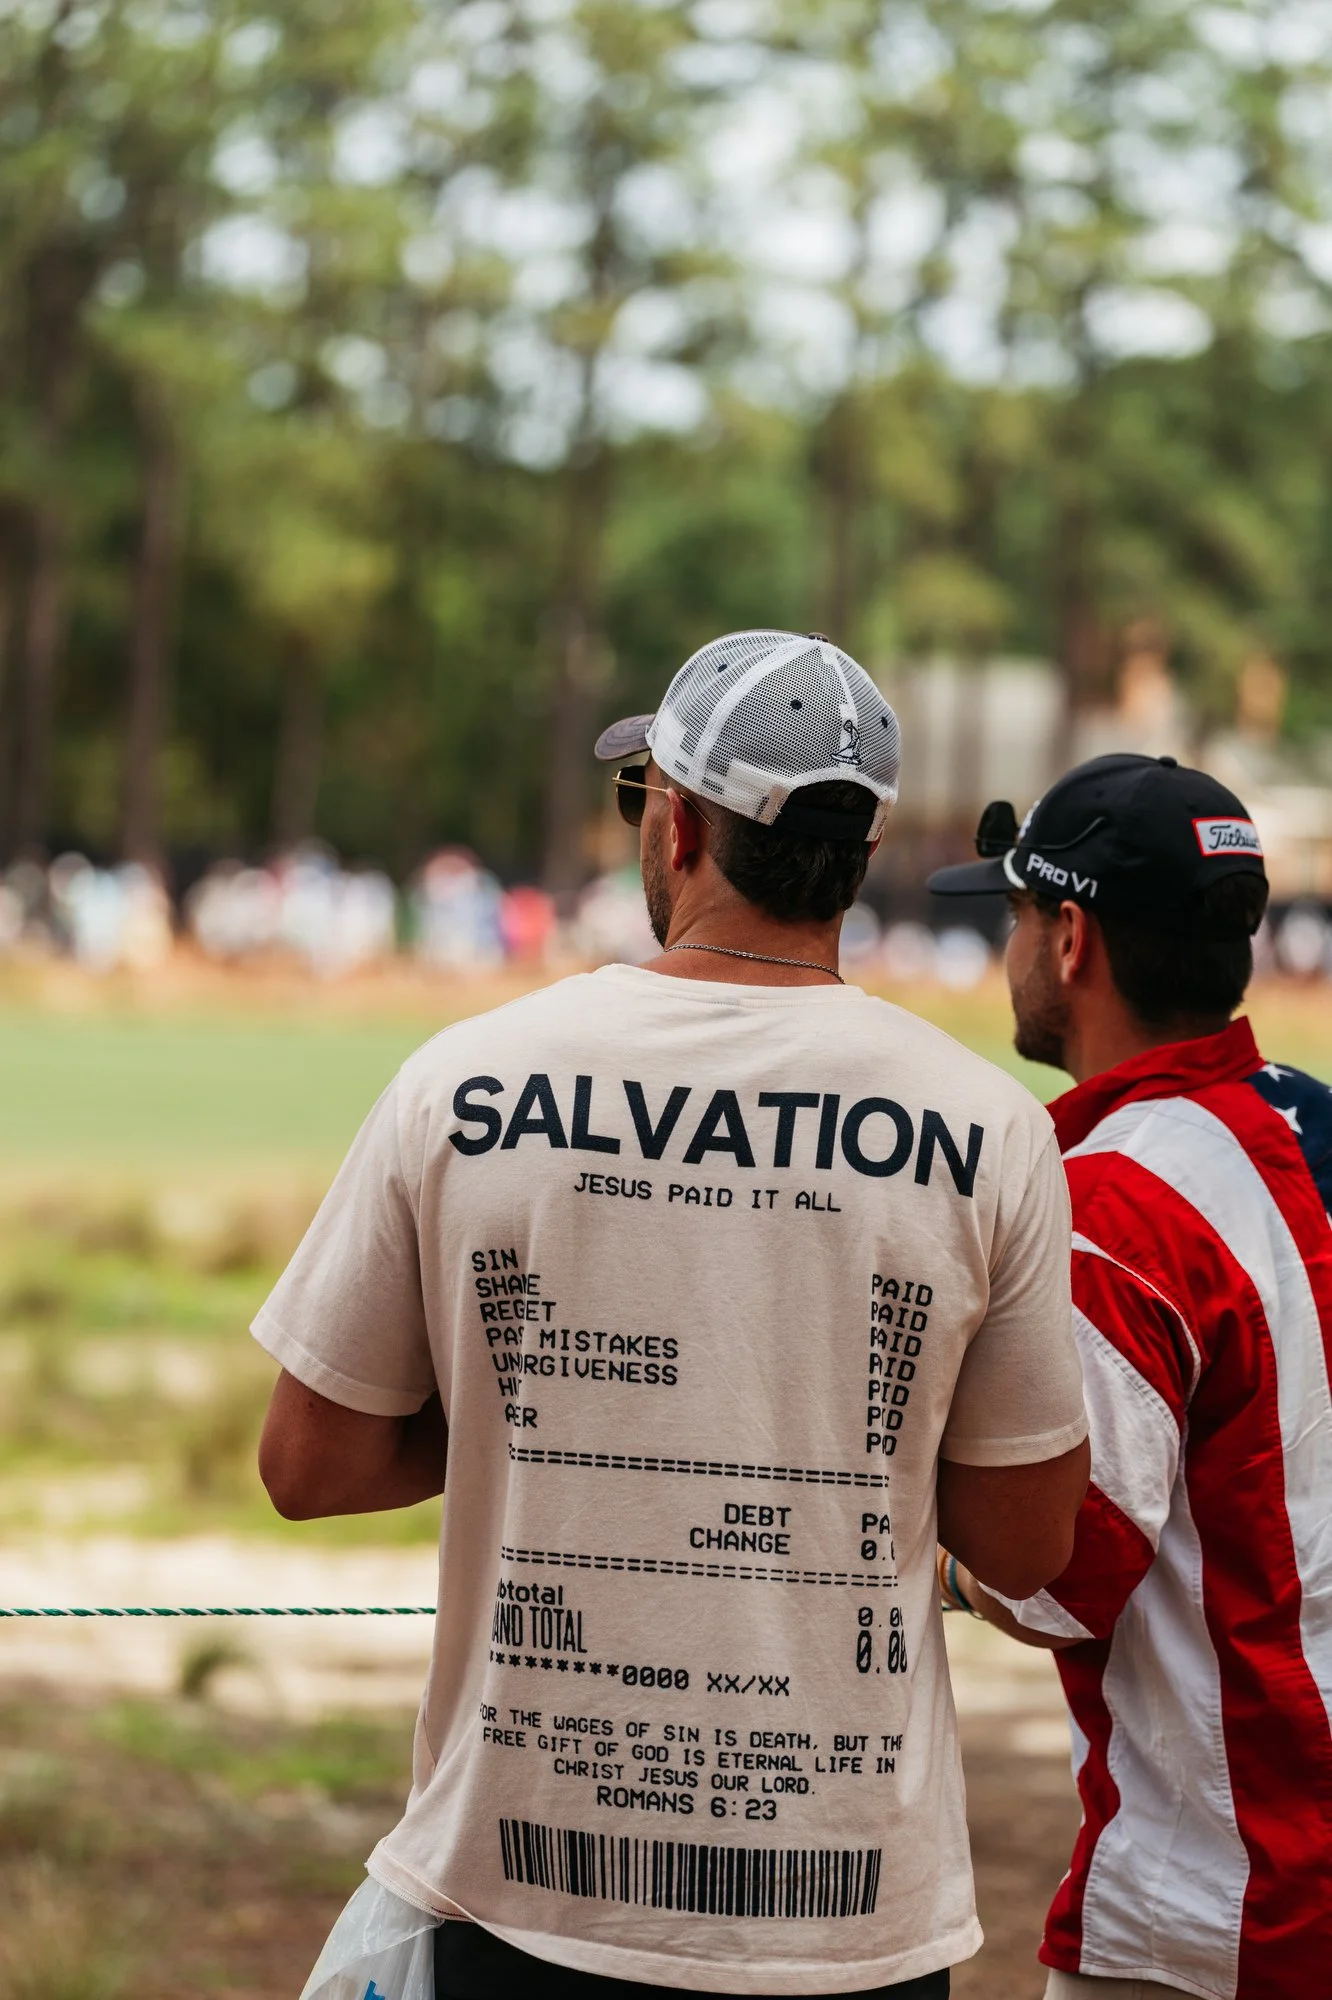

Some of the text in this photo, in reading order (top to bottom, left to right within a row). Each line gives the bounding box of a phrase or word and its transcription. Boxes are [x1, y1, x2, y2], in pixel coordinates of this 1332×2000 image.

[1026, 853, 1098, 899] PRO V1
[448, 1074, 984, 1198] SALVATION
[574, 1173, 841, 1212] JESUS PAID IT ALL
[472, 1248, 519, 1272] SIN
[872, 1274, 933, 1307] PAID
[871, 1301, 928, 1332] PAID
[539, 1329, 678, 1359] MISTAKES
[724, 1503, 792, 1528] DEBT
[690, 1527, 791, 1555] CHANGE
[529, 1606, 587, 1653] TOTAL
[707, 1672, 789, 1696] XX/XX
[509, 1709, 542, 1728] THE
[554, 1716, 613, 1736] WAGES
[626, 1721, 650, 1738] OF
[664, 1725, 699, 1742] SIN
[715, 1729, 737, 1746] IS
[750, 1731, 817, 1750] DEATH,
[834, 1735, 869, 1752] BUT
[483, 1727, 895, 1774] FREE GIFT OF GOD IS ETERNAL LIFE IN
[554, 1758, 815, 1794] CHRIST JESUS OUR LORD.
[597, 1785, 776, 1820] ROMANS 6:23
